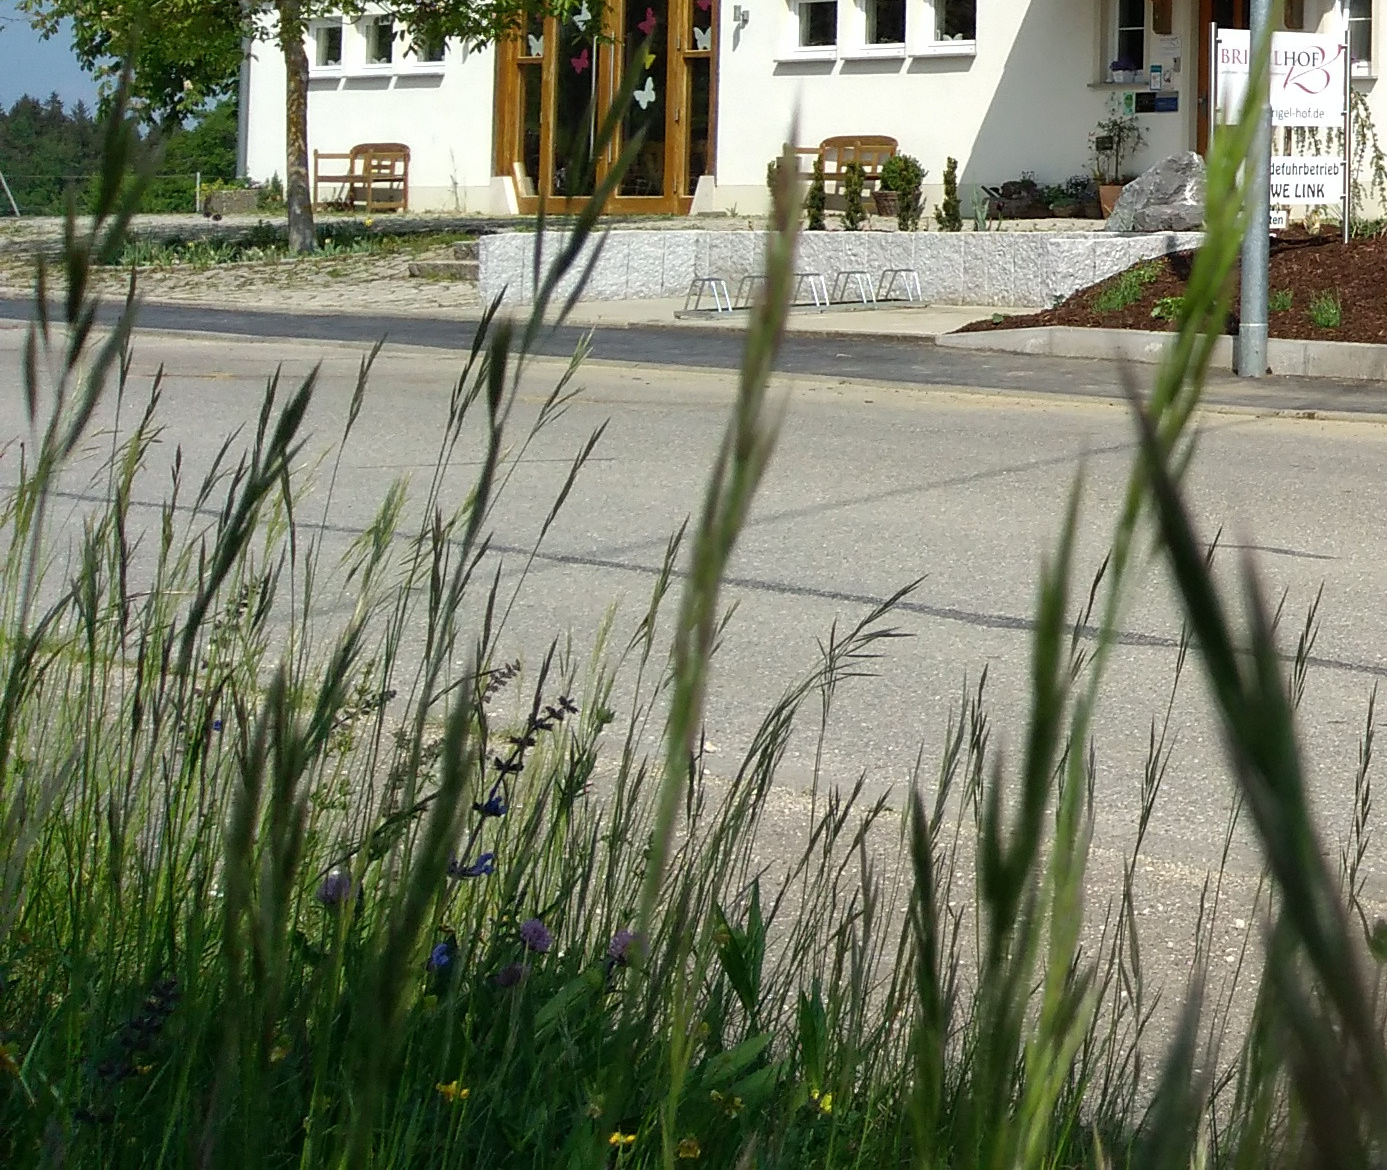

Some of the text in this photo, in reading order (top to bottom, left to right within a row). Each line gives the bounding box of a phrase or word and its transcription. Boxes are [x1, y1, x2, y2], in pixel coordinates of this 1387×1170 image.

[1221, 49, 1319, 66] BRILHOF
[1271, 107, 1324, 120] rigel-hof.de
[1270, 163, 1339, 175] defuhrbetrieb
[1270, 184, 1324, 198] WE LINK
